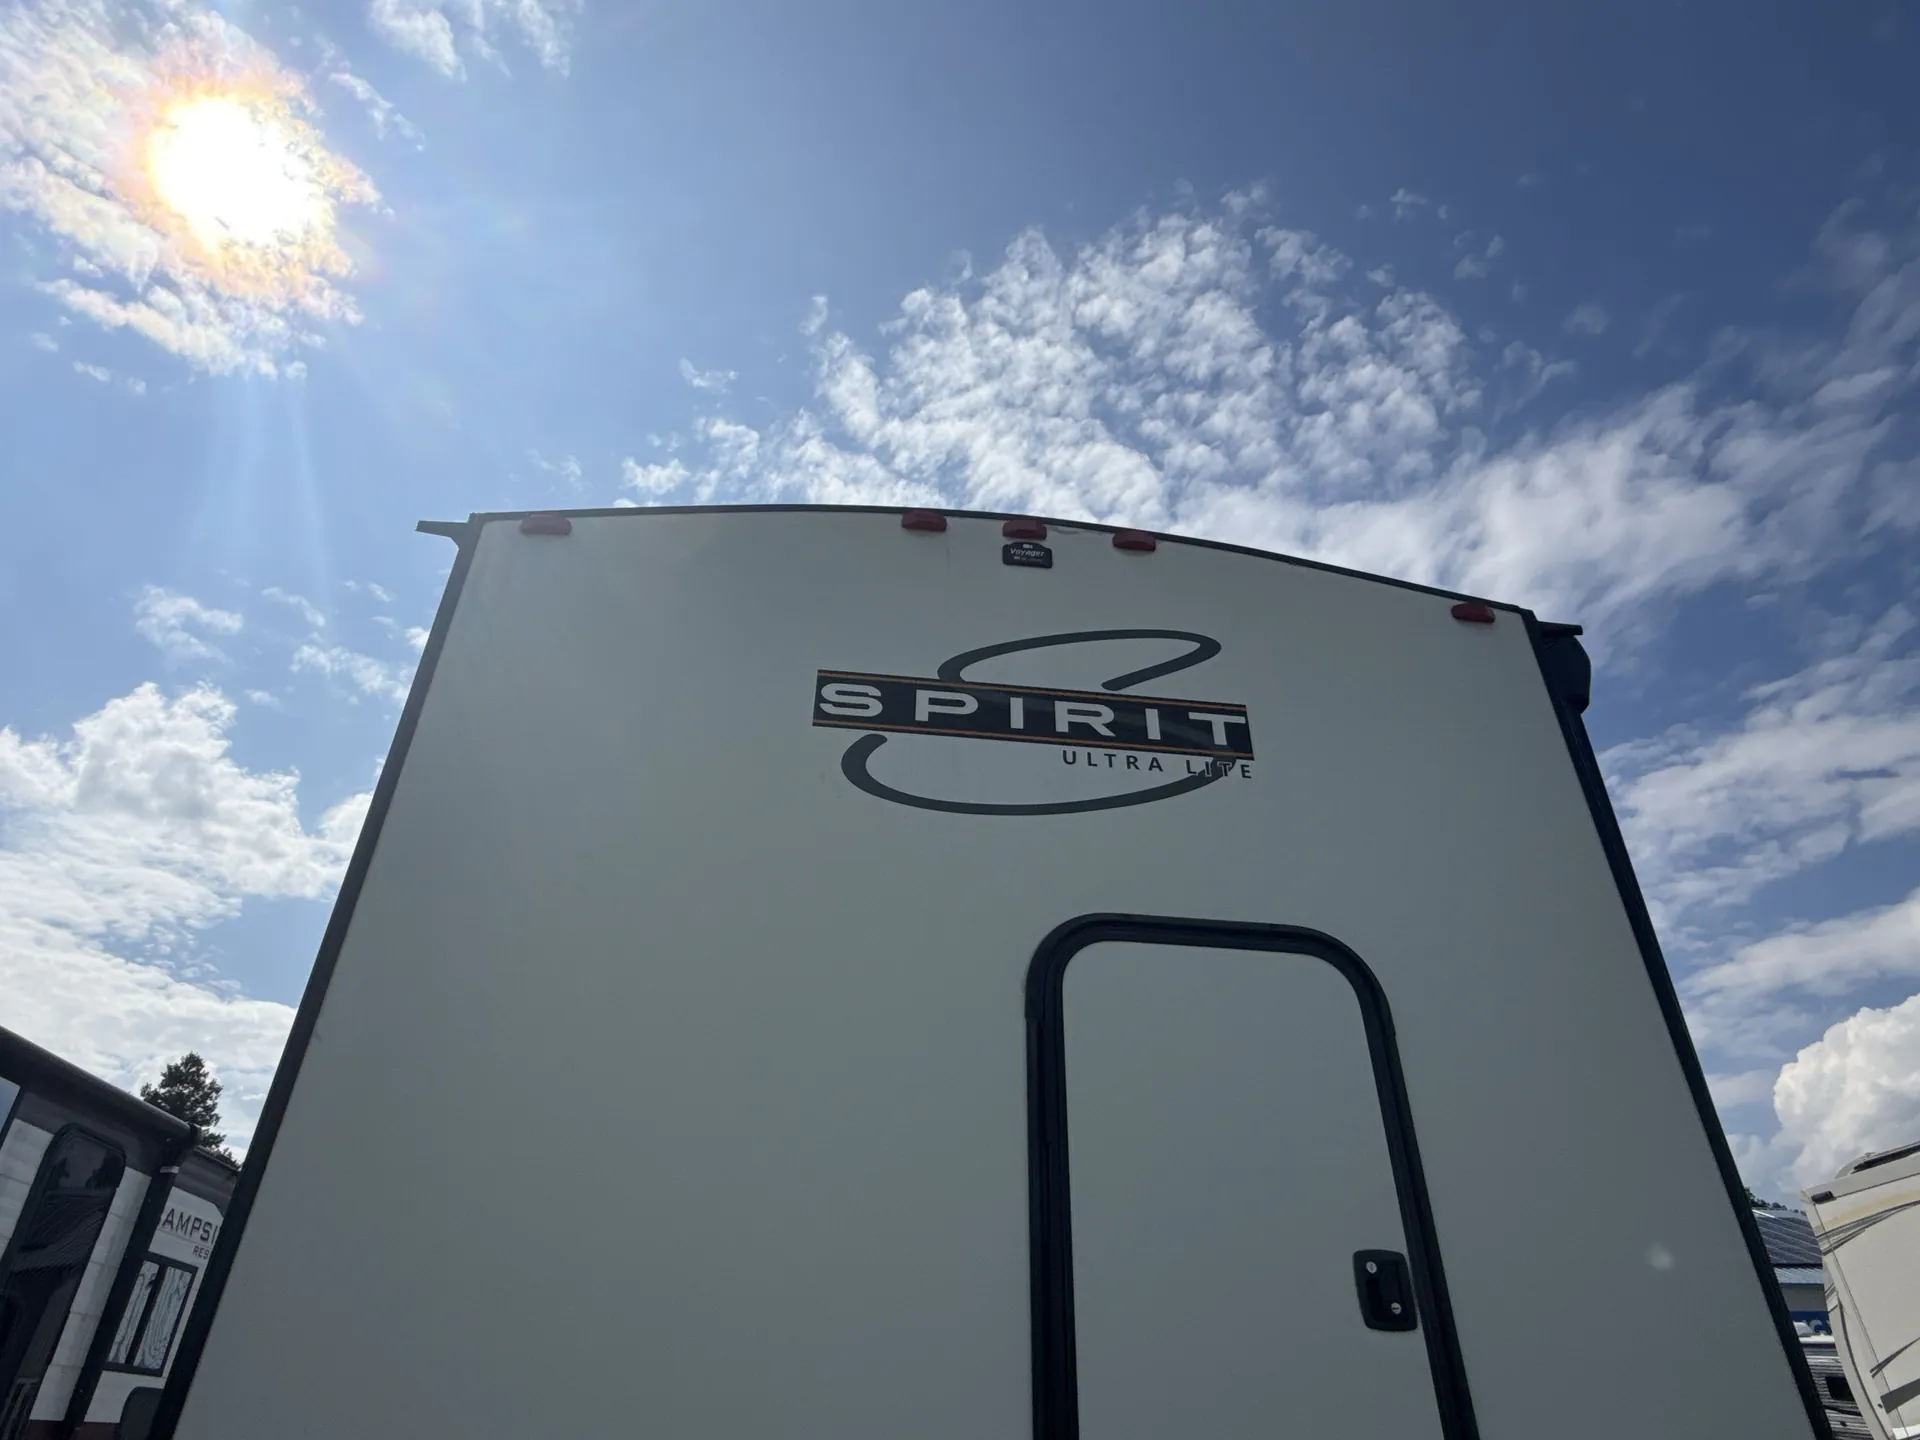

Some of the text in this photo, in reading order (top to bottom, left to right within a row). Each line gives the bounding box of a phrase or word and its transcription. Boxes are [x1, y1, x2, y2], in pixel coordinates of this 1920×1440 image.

[1010, 548, 1045, 557] Voyager
[819, 682, 1246, 746] SPIRIT
[1062, 750, 1252, 779] ULTRA LITE
